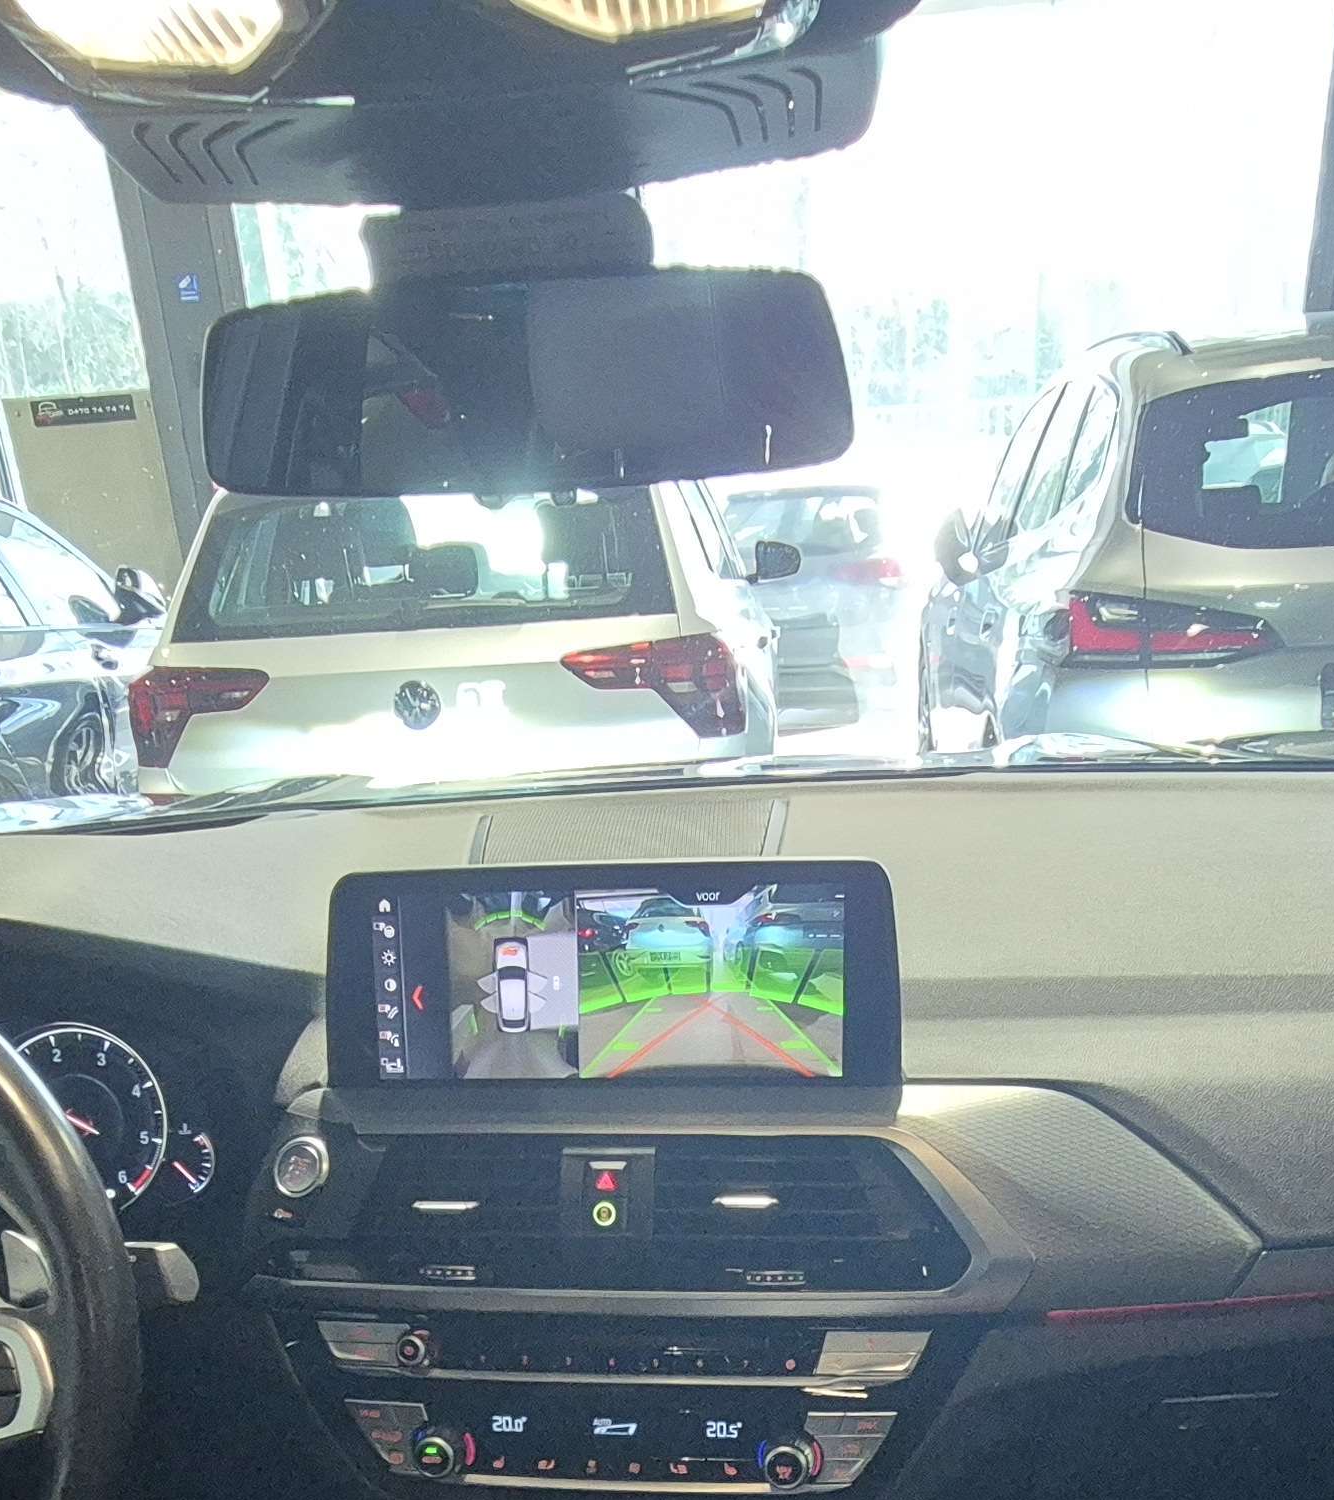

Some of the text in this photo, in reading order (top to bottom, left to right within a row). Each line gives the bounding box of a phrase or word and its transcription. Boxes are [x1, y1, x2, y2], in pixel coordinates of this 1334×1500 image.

[696, 886, 721, 901] voor
[52, 1049, 62, 1063] 2
[96, 1052, 107, 1066] 3
[131, 1083, 141, 1098] 4
[139, 1131, 149, 1145] 5
[118, 1170, 128, 1184] 6
